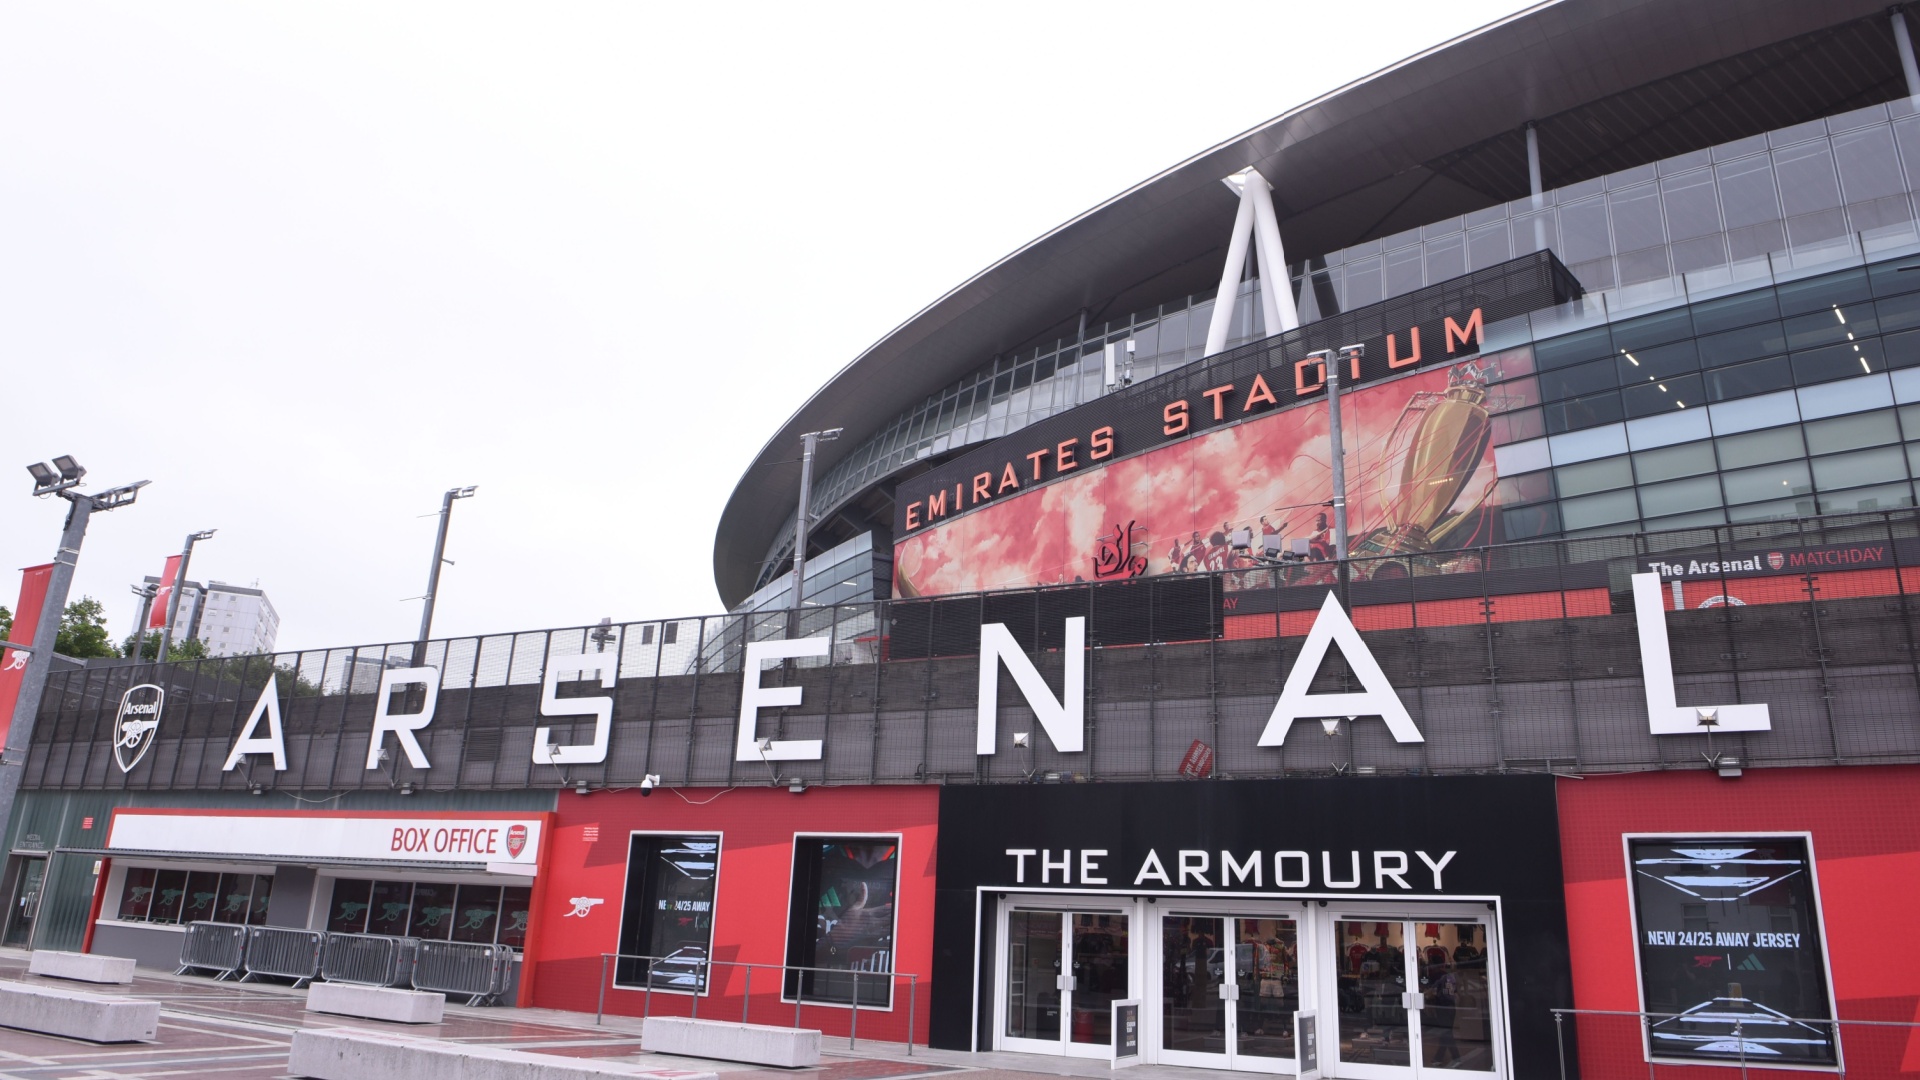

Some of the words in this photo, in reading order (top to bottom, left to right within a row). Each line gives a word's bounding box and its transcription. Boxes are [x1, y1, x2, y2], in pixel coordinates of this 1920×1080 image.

[906, 425, 1114, 531] EMIRATES
[1163, 307, 1485, 436] STADIUM
[1648, 561, 1684, 577] The
[1688, 555, 1762, 575] Arsenal
[1789, 547, 1884, 567] MATCHDAY
[222, 572, 1772, 772] ARSENAL
[124, 701, 158, 715] Arsenal
[19, 841, 45, 849] ENTRANCE
[391, 827, 430, 852] BOX
[434, 828, 499, 854] OFFICE
[1006, 848, 1108, 885] THE
[1133, 848, 1457, 890] ARMOURY
[692, 901, 711, 912] AWAY
[1647, 930, 1676, 946] NEW
[1678, 931, 1713, 946] 24/25
[1715, 932, 1750, 947] AWAY
[1752, 933, 1800, 948] JERSEY
